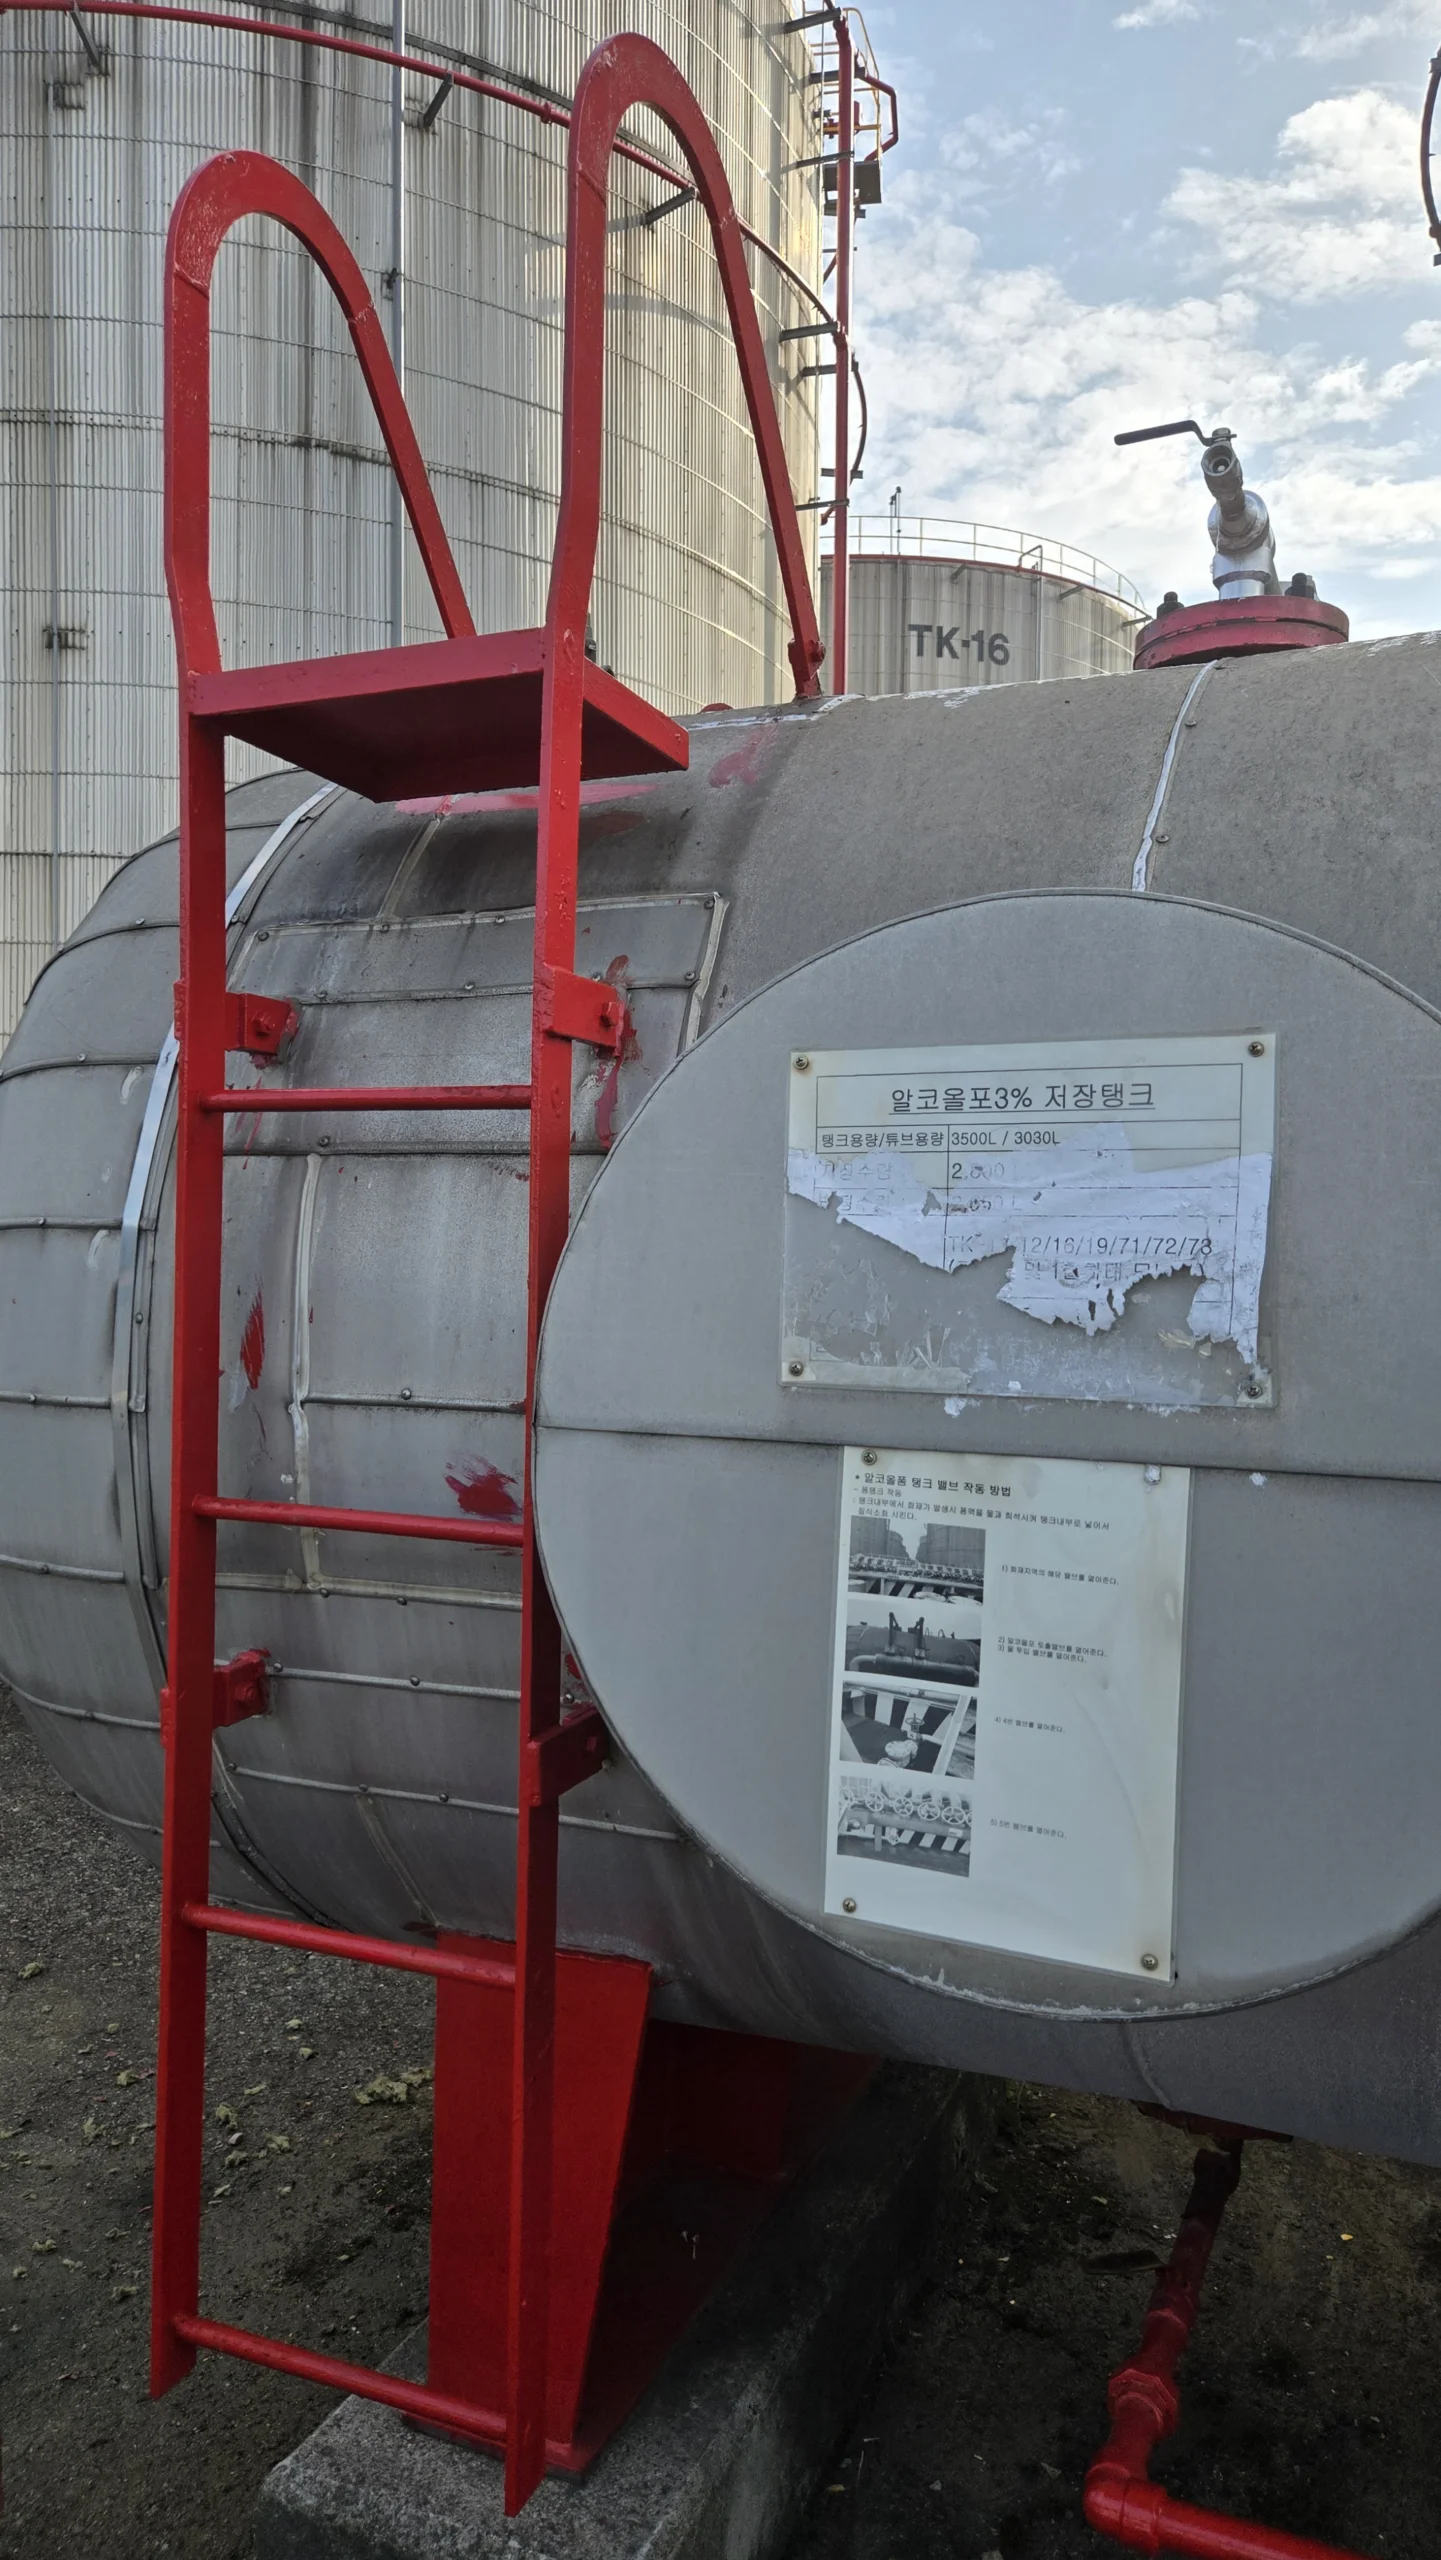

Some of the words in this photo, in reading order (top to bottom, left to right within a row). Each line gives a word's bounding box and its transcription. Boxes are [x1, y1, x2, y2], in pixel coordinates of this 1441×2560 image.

[908, 624, 1010, 666] TK-16
[891, 1086, 1033, 1113] 알코올포3%
[1044, 1082, 1154, 1109] 저장탱크
[821, 1131, 944, 1148] 탱크용량/튜브용량
[951, 1131, 997, 1146] 3500L
[1014, 1130, 1061, 1146] 3030L
[864, 1472, 907, 1487] 알코올폼
[911, 1477, 933, 1489] 탱크
[937, 1479, 959, 1492] 밸브
[963, 1482, 985, 1495] 작동
[989, 1485, 1011, 1497] 방법
[858, 1497, 904, 1508] 탱크내부에서
[907, 1502, 930, 1512] 화재가
[933, 1504, 957, 1514] 발생시
[1040, 1515, 1082, 1528] 탱크내부로
